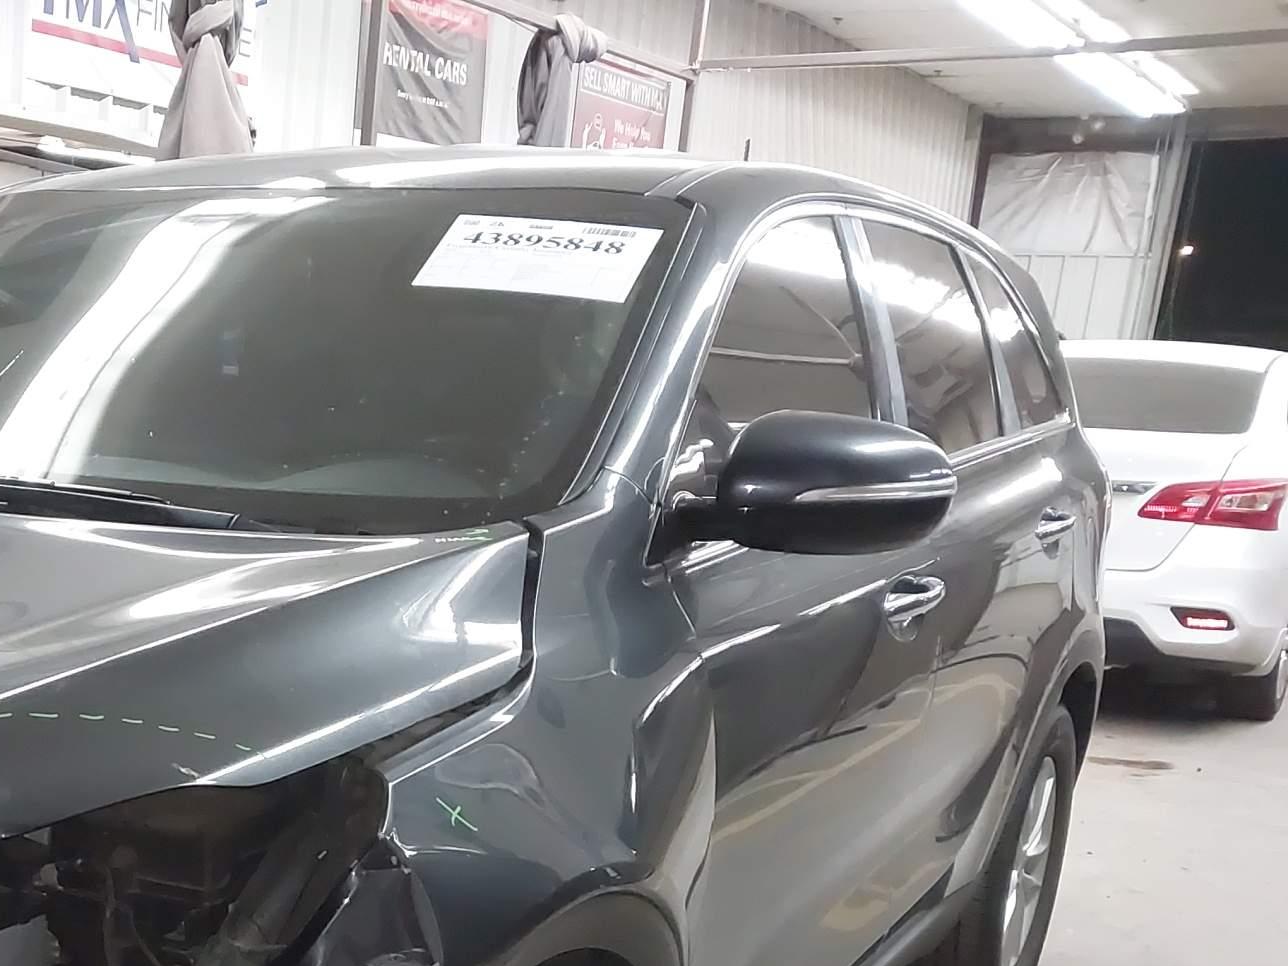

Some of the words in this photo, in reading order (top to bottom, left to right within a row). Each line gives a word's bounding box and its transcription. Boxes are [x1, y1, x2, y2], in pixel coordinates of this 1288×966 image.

[383, 41, 431, 77] RENTAL
[434, 57, 467, 86] CARS
[583, 66, 602, 91] SELL
[603, 72, 632, 100] SMART
[464, 231, 626, 254] 43895848
